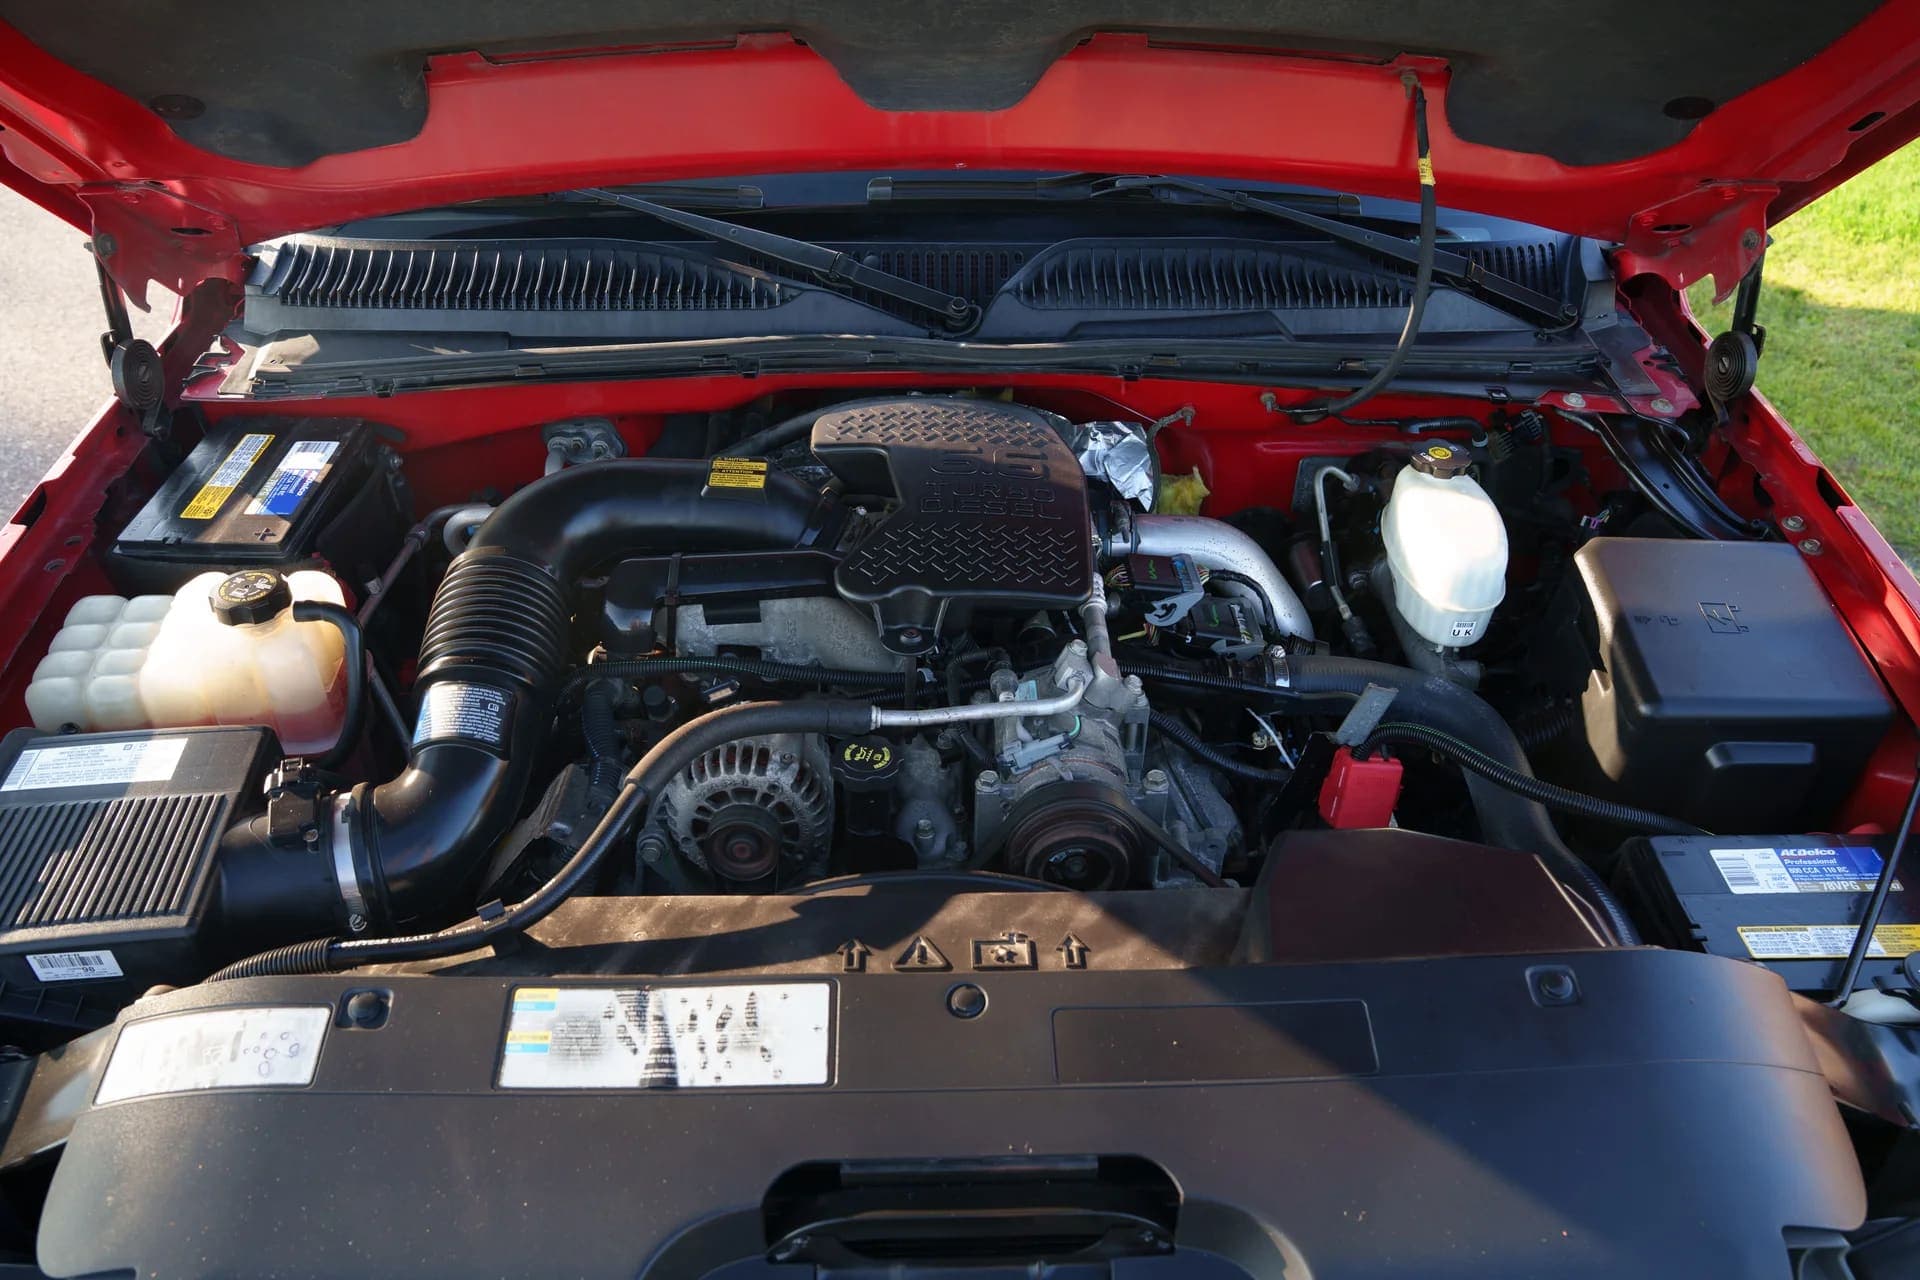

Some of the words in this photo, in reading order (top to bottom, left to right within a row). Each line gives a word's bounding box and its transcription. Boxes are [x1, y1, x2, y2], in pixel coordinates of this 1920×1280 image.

[924, 480, 1057, 503] TURBO
[920, 496, 1062, 520] DIESEL
[1781, 848, 1836, 857] ACDelco
[1784, 858, 1838, 866] Professional
